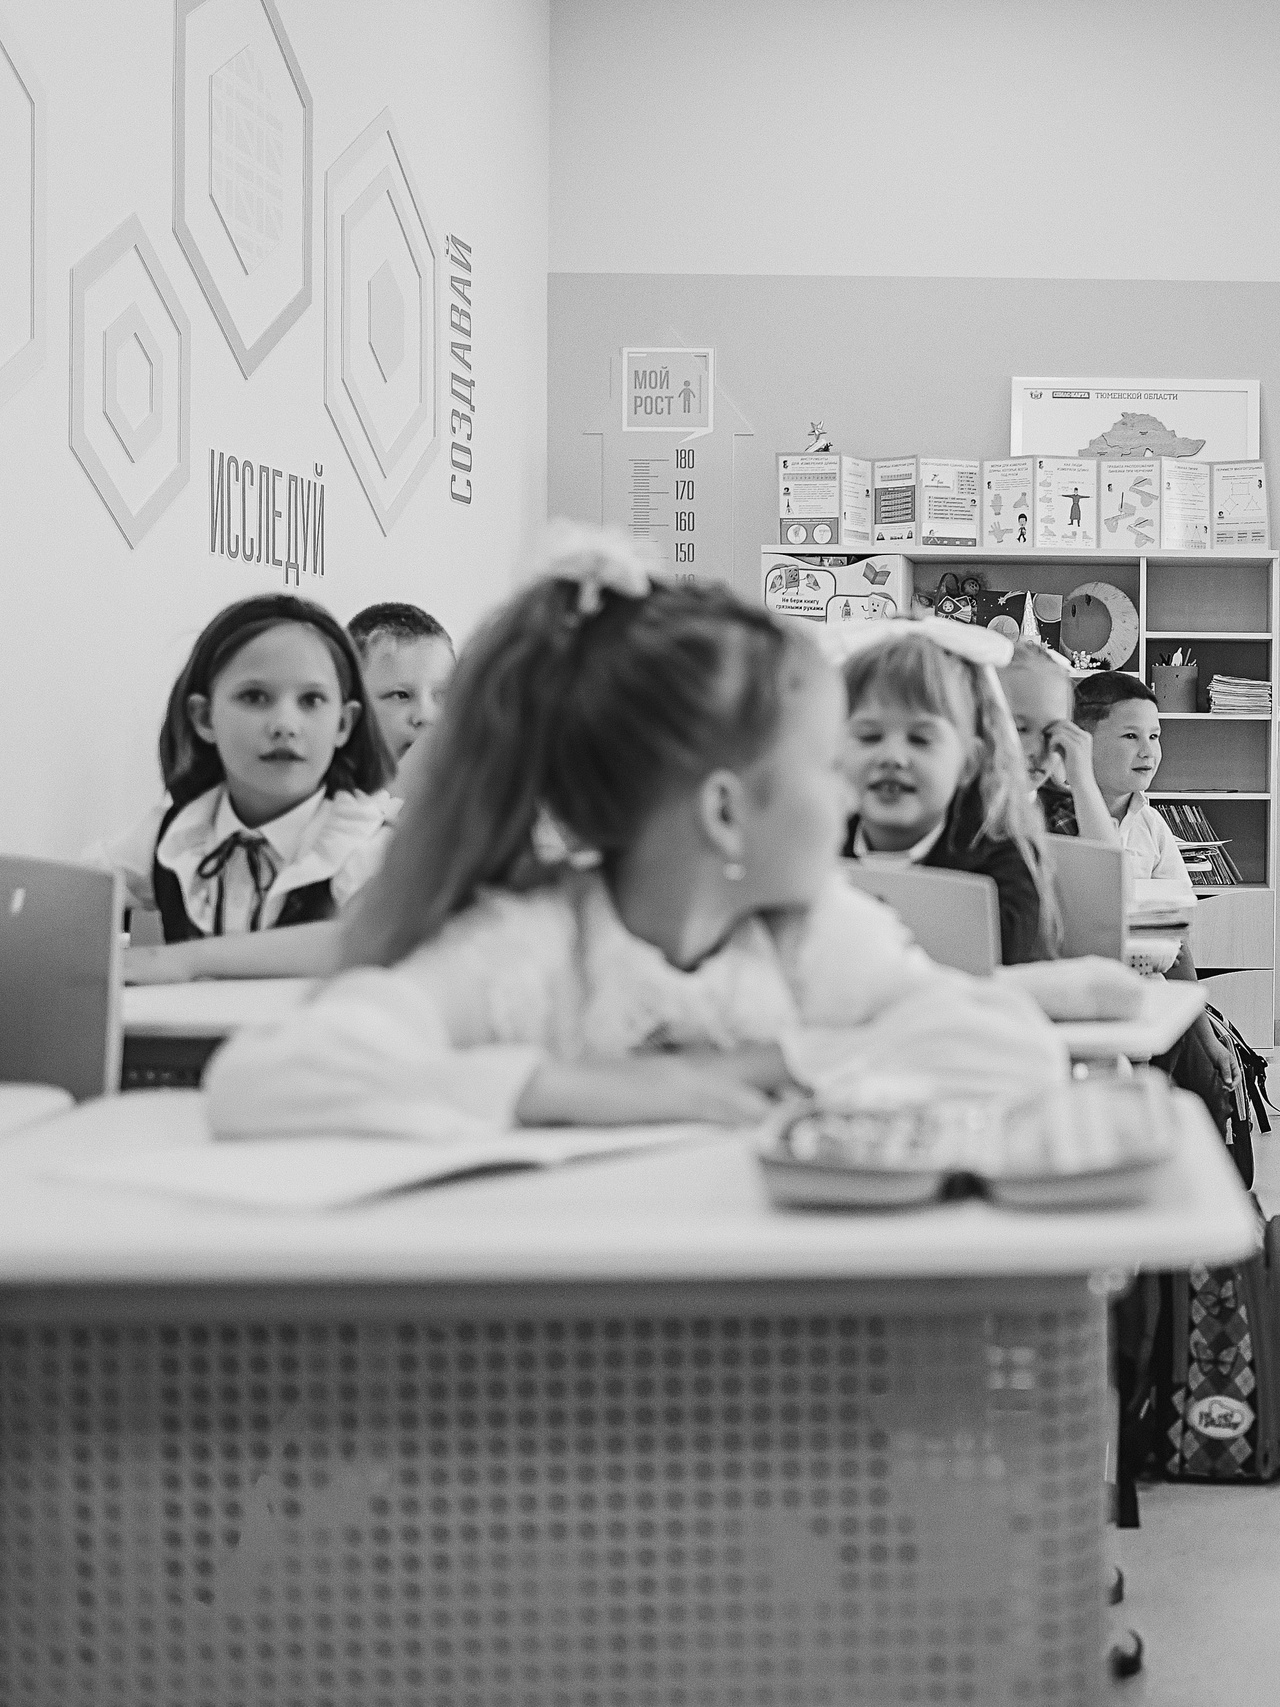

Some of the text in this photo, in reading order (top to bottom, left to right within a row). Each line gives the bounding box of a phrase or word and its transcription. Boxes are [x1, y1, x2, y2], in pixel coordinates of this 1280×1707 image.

[445, 234, 475, 505] СОЗДАВАЙ
[634, 367, 670, 389] МОЙ
[634, 396, 674, 415] РОСТ
[1095, 391, 1142, 400] ТЮМЕНСКОЙ
[1143, 392, 1178, 400] ОБЛАСТИ
[675, 449, 695, 469] 180
[675, 480, 695, 500] 170
[210, 449, 324, 586] ИССЛЕДУЙ
[675, 511, 695, 531] 160
[675, 543, 695, 562] 150
